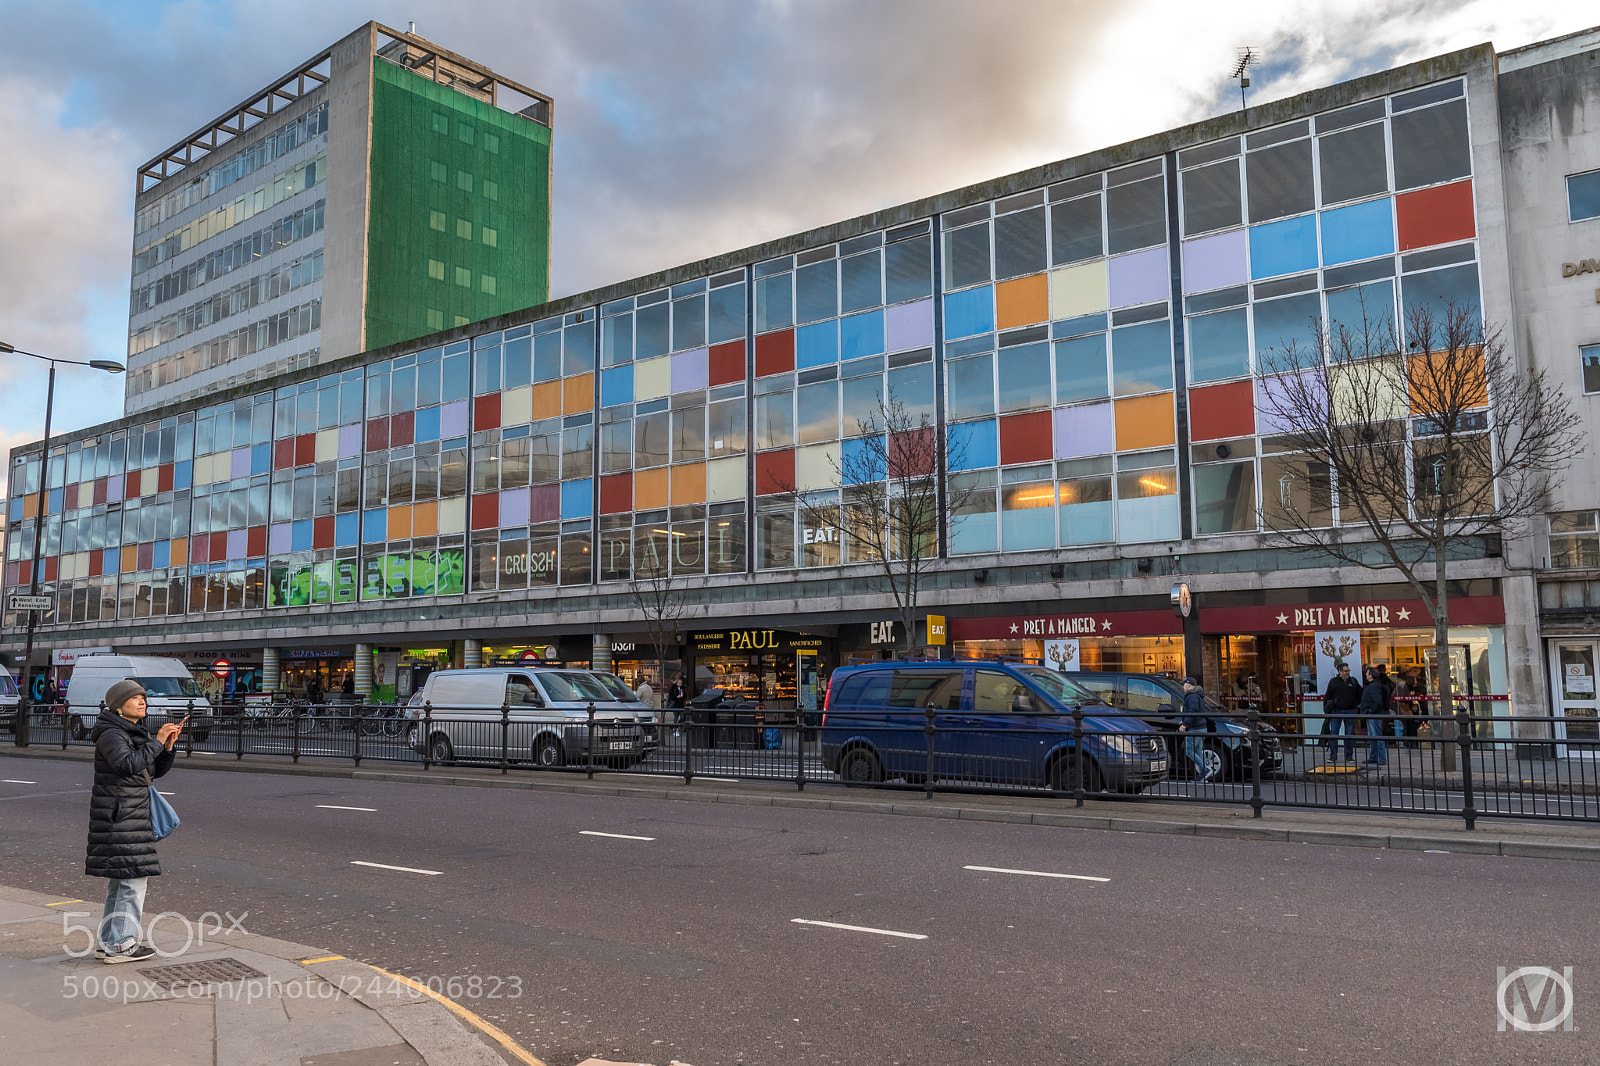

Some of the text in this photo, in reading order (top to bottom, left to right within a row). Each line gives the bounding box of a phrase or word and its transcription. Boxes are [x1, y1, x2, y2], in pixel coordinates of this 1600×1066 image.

[803, 527, 838, 545] EAT.
[607, 528, 739, 573] PAUL
[505, 551, 554, 575] CRUSSH
[1294, 605, 1390, 626] PRET A MANGER
[870, 620, 896, 644] EAT.
[931, 624, 945, 635] EAT.
[1023, 617, 1097, 635] PRET A MANGER
[729, 630, 779, 649] PAUL
[194, 651, 217, 659] FOOD
[230, 651, 252, 659] WINE
